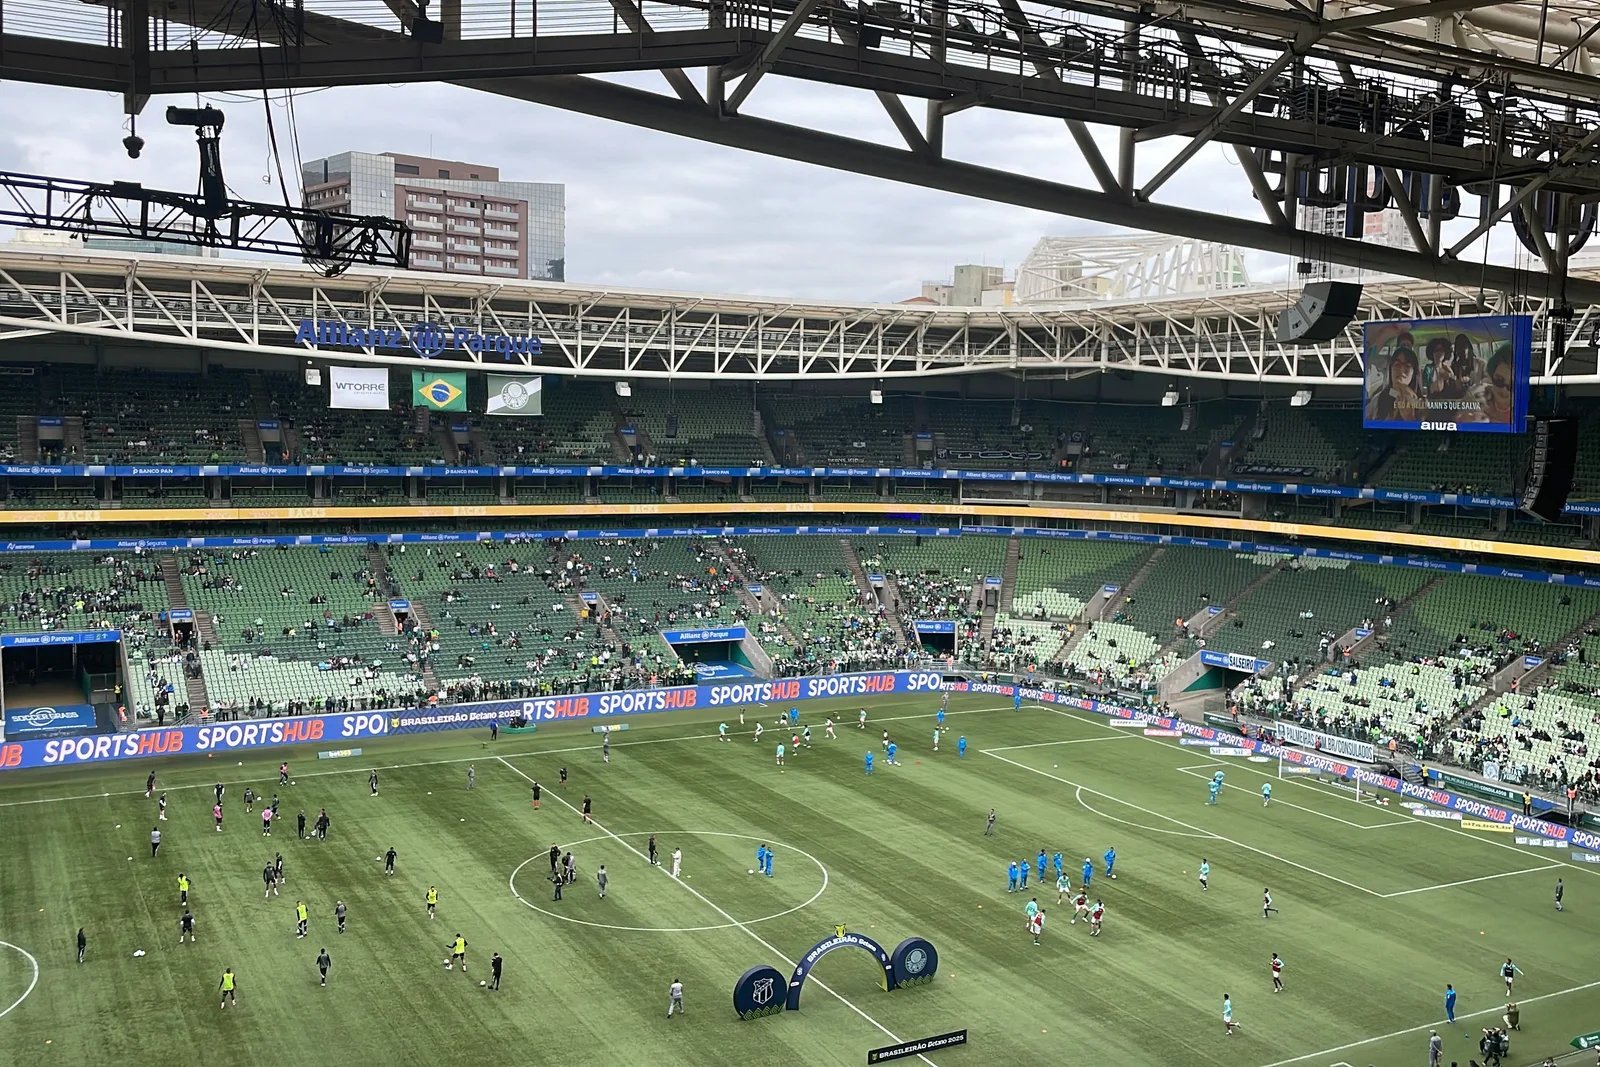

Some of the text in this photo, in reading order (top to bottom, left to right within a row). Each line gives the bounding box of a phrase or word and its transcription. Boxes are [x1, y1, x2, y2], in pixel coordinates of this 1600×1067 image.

[295, 320, 543, 360] Allianz Parque
[335, 382, 385, 391] WTORRE
[1448, 402, 1460, 411] QUE
[1421, 422, 1457, 431] aiwa
[1409, 493, 1426, 501] Seguros
[1497, 499, 1514, 507] Parque
[1429, 561, 1446, 569] Seguros
[14, 635, 40, 644] Allianz
[51, 634, 74, 643] Parque
[709, 631, 729, 639] Parque
[1205, 653, 1222, 662] Allianz
[1229, 656, 1254, 670] SALSEIRO
[808, 675, 895, 697] SPORTSHUB
[907, 673, 943, 690] SPO
[972, 683, 1014, 695] SPORTSHUB
[710, 681, 800, 704] SPORTSHUB
[599, 689, 697, 715] SPORTSHUB
[1057, 695, 1093, 709] SPORTSHUB
[1096, 703, 1132, 719] SPORTSHUB
[341, 714, 388, 737] SPO
[400, 709, 521, 727] BRASILEIRÃO Betano 2025
[1134, 711, 1171, 728] SPORTSHUB
[196, 719, 324, 750] SPORTSHUB
[1174, 721, 1215, 739] SPORTSHUB
[43, 731, 184, 763] SPORTSHUB
[1216, 732, 1257, 750] SPORTSHUB
[1304, 756, 1348, 775] SPORTSHUB
[1401, 782, 1450, 805] SPORTSHUB
[1455, 798, 1506, 822] SPORTSHUB
[1510, 813, 1567, 839] SPORTSHUB
[1572, 831, 1600, 850] SPOR
[807, 935, 857, 962] BRASILEIRÃO
[879, 1034, 964, 1059] BRASILEIRÃO Betano 2025
